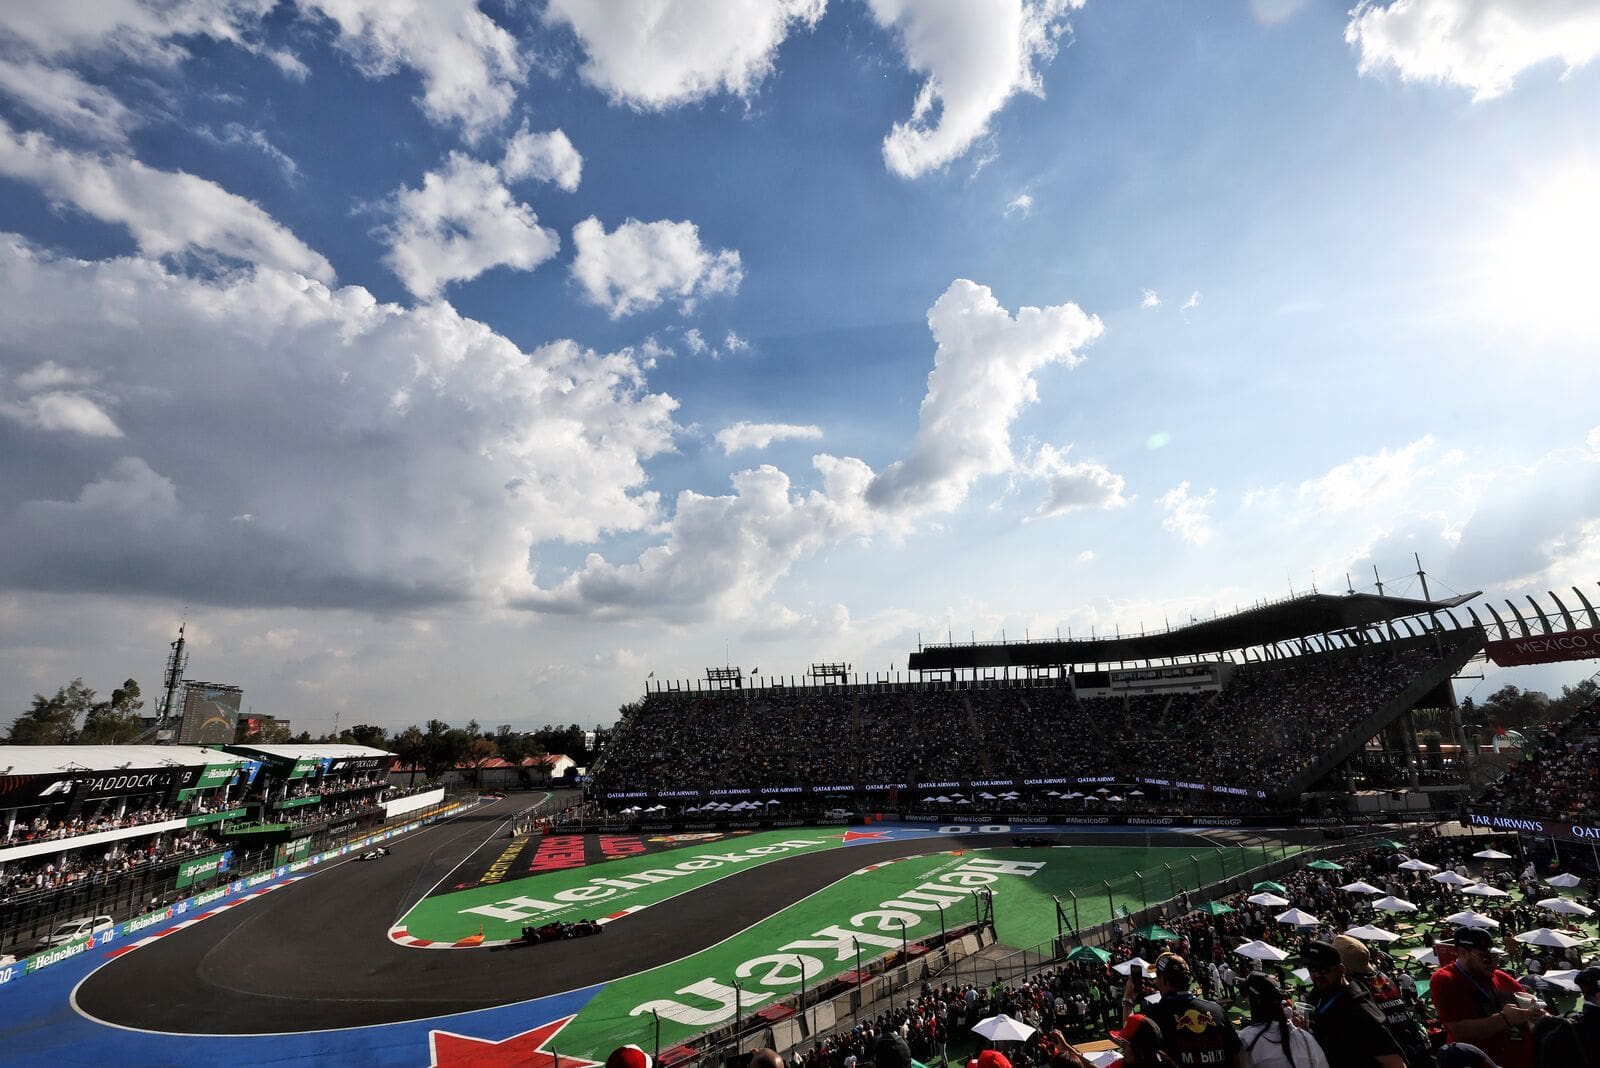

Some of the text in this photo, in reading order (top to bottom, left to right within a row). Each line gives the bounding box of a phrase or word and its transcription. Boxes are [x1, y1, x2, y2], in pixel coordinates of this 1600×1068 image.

[1516, 636, 1587, 654] MEXICO
[1470, 814, 1543, 831] TAR AIRWAYS
[458, 839, 826, 923] Heineken
[198, 890, 224, 906] Heineken
[130, 913, 166, 932] Heineken
[629, 858, 1047, 1025] Heineken
[35, 943, 84, 969] Heineken
[1182, 1051, 1216, 1064] Mbil
